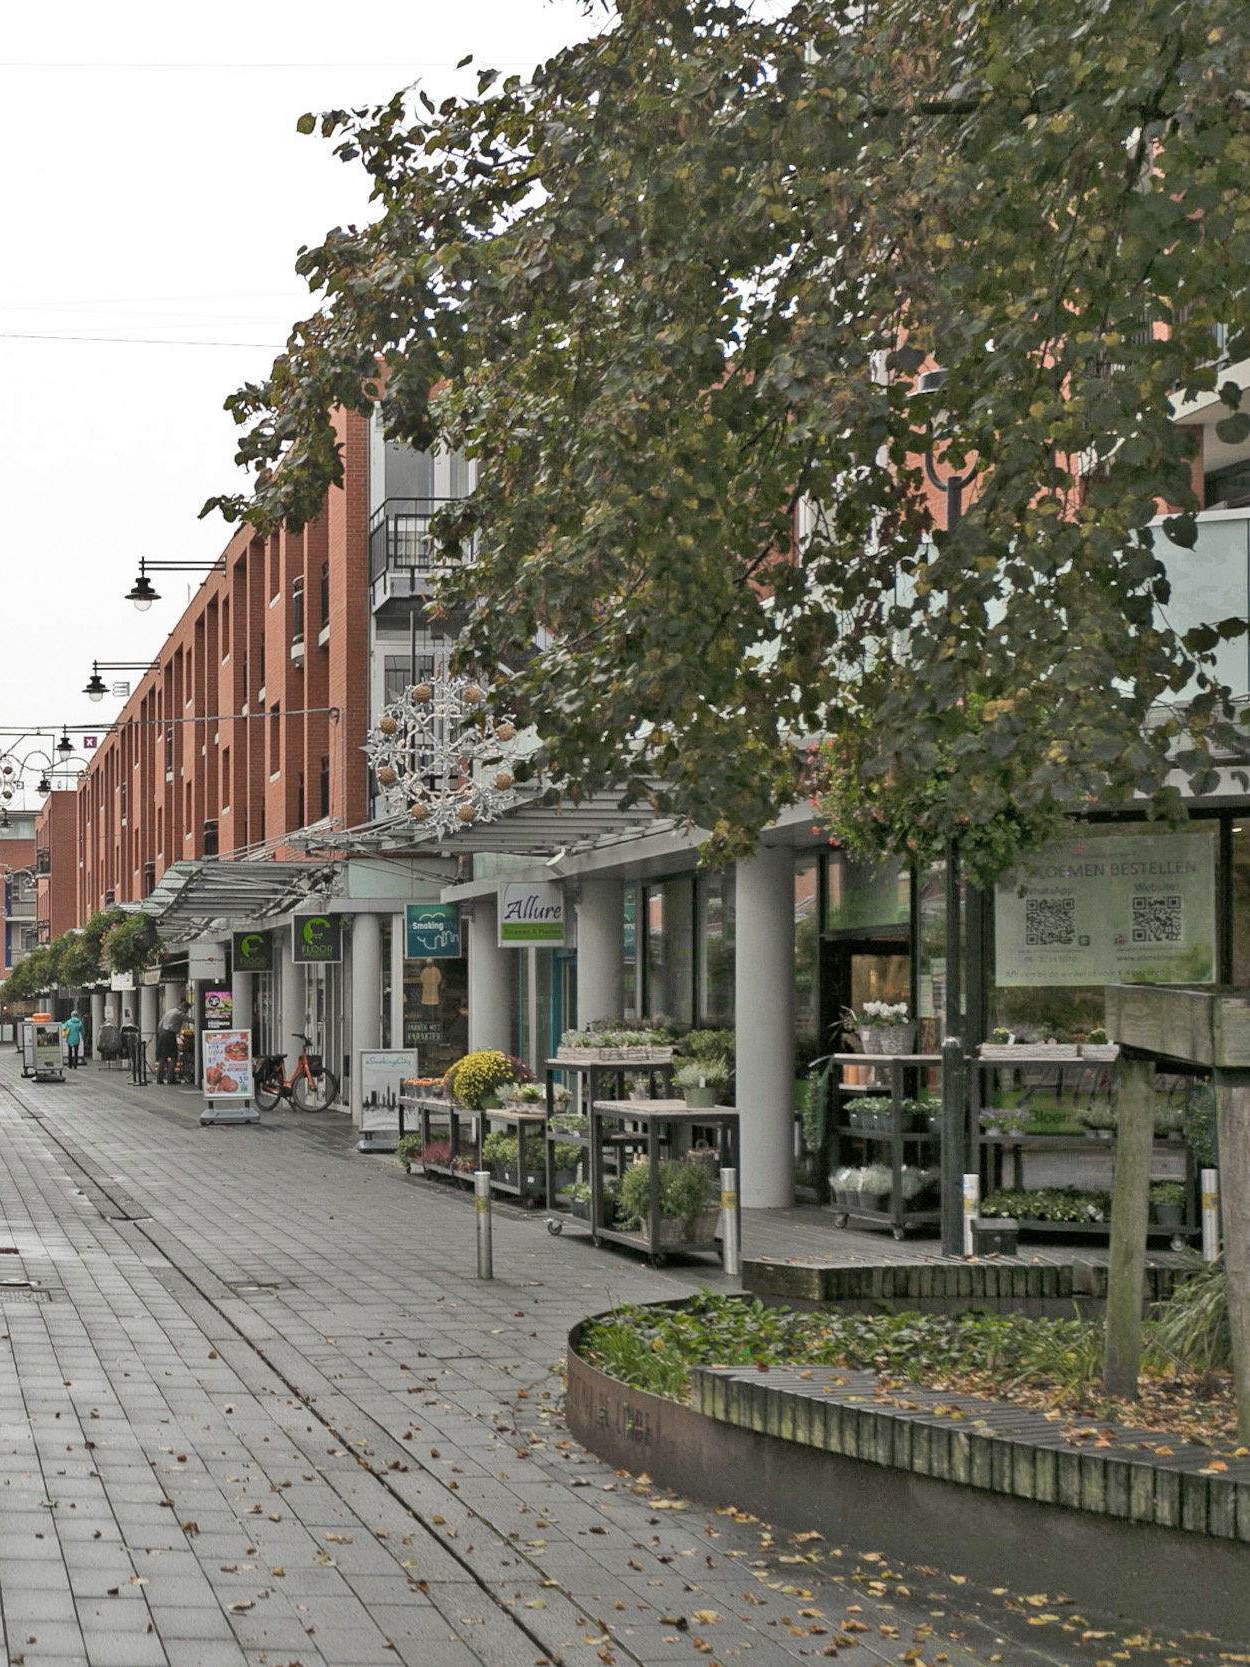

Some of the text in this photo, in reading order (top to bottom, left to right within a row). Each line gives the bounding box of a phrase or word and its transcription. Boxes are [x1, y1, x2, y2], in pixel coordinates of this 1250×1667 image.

[1029, 860, 1197, 879] LOEMEN BESTELLEN
[504, 895, 562, 920] Allure
